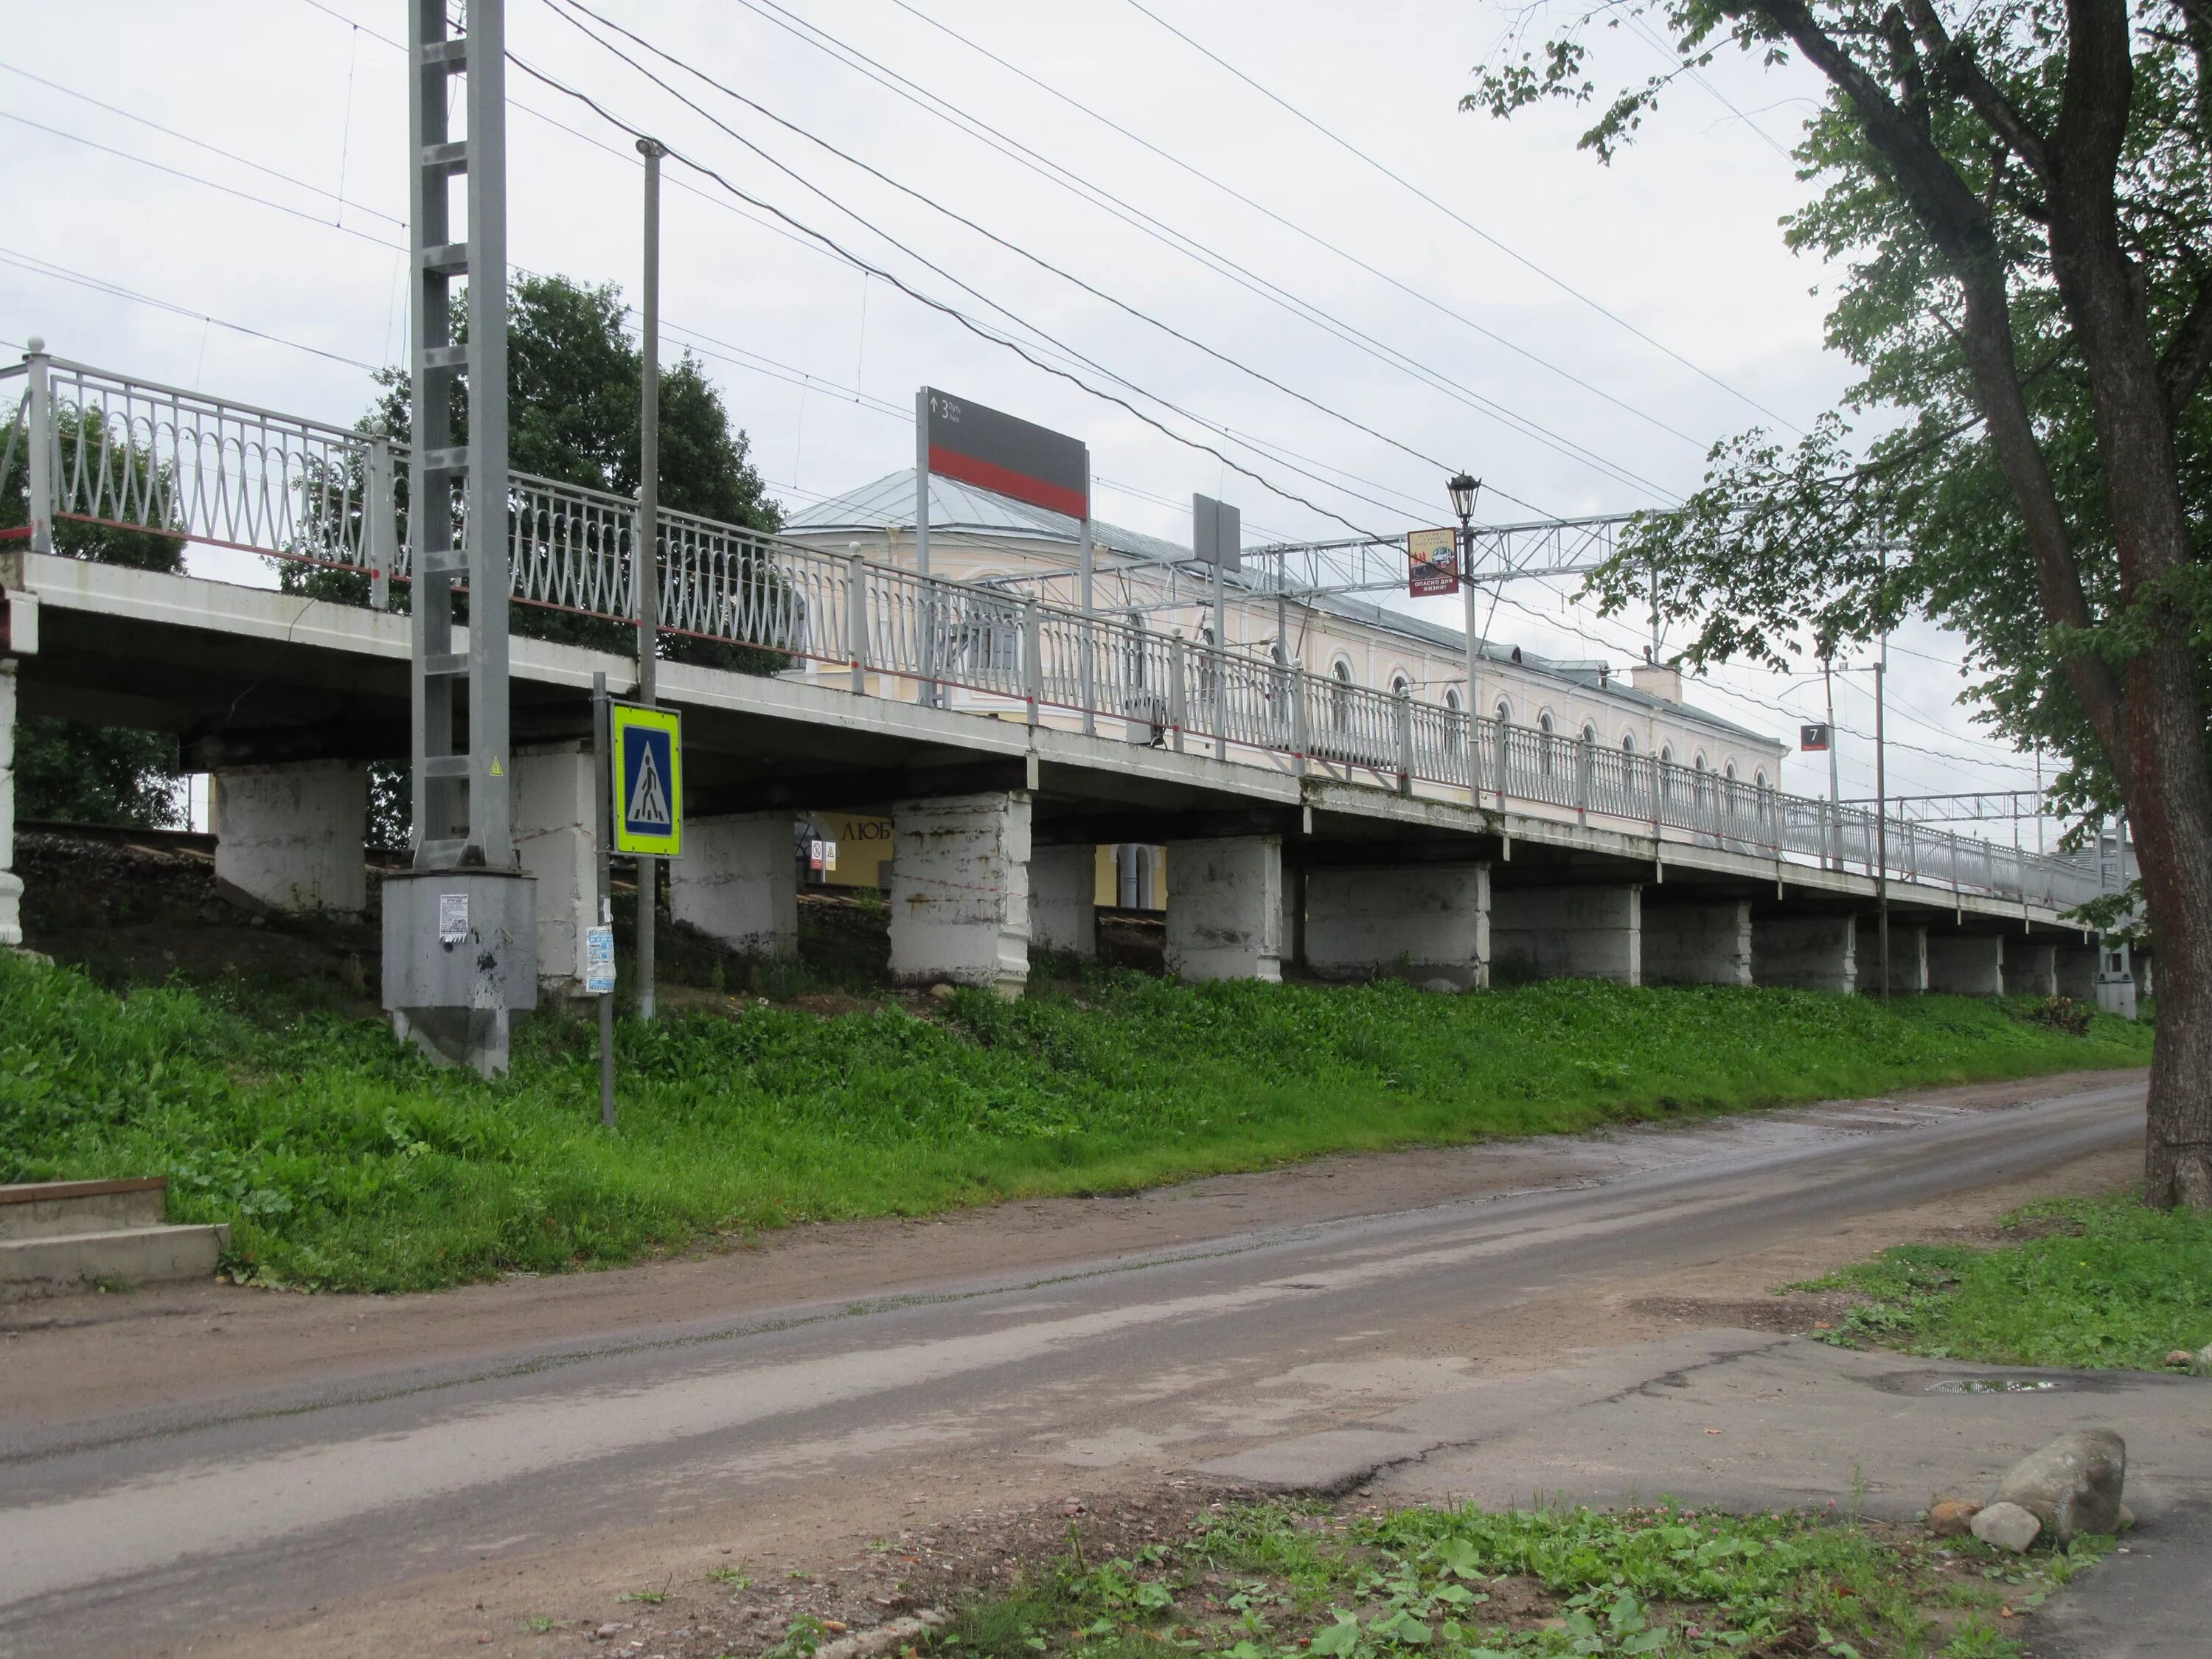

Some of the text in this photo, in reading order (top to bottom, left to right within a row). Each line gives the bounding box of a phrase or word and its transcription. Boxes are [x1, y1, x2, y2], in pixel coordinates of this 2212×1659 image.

[942, 399, 948, 419] 3
[1809, 728, 1818, 741] 7
[842, 821, 891, 841] ЛЮБ
